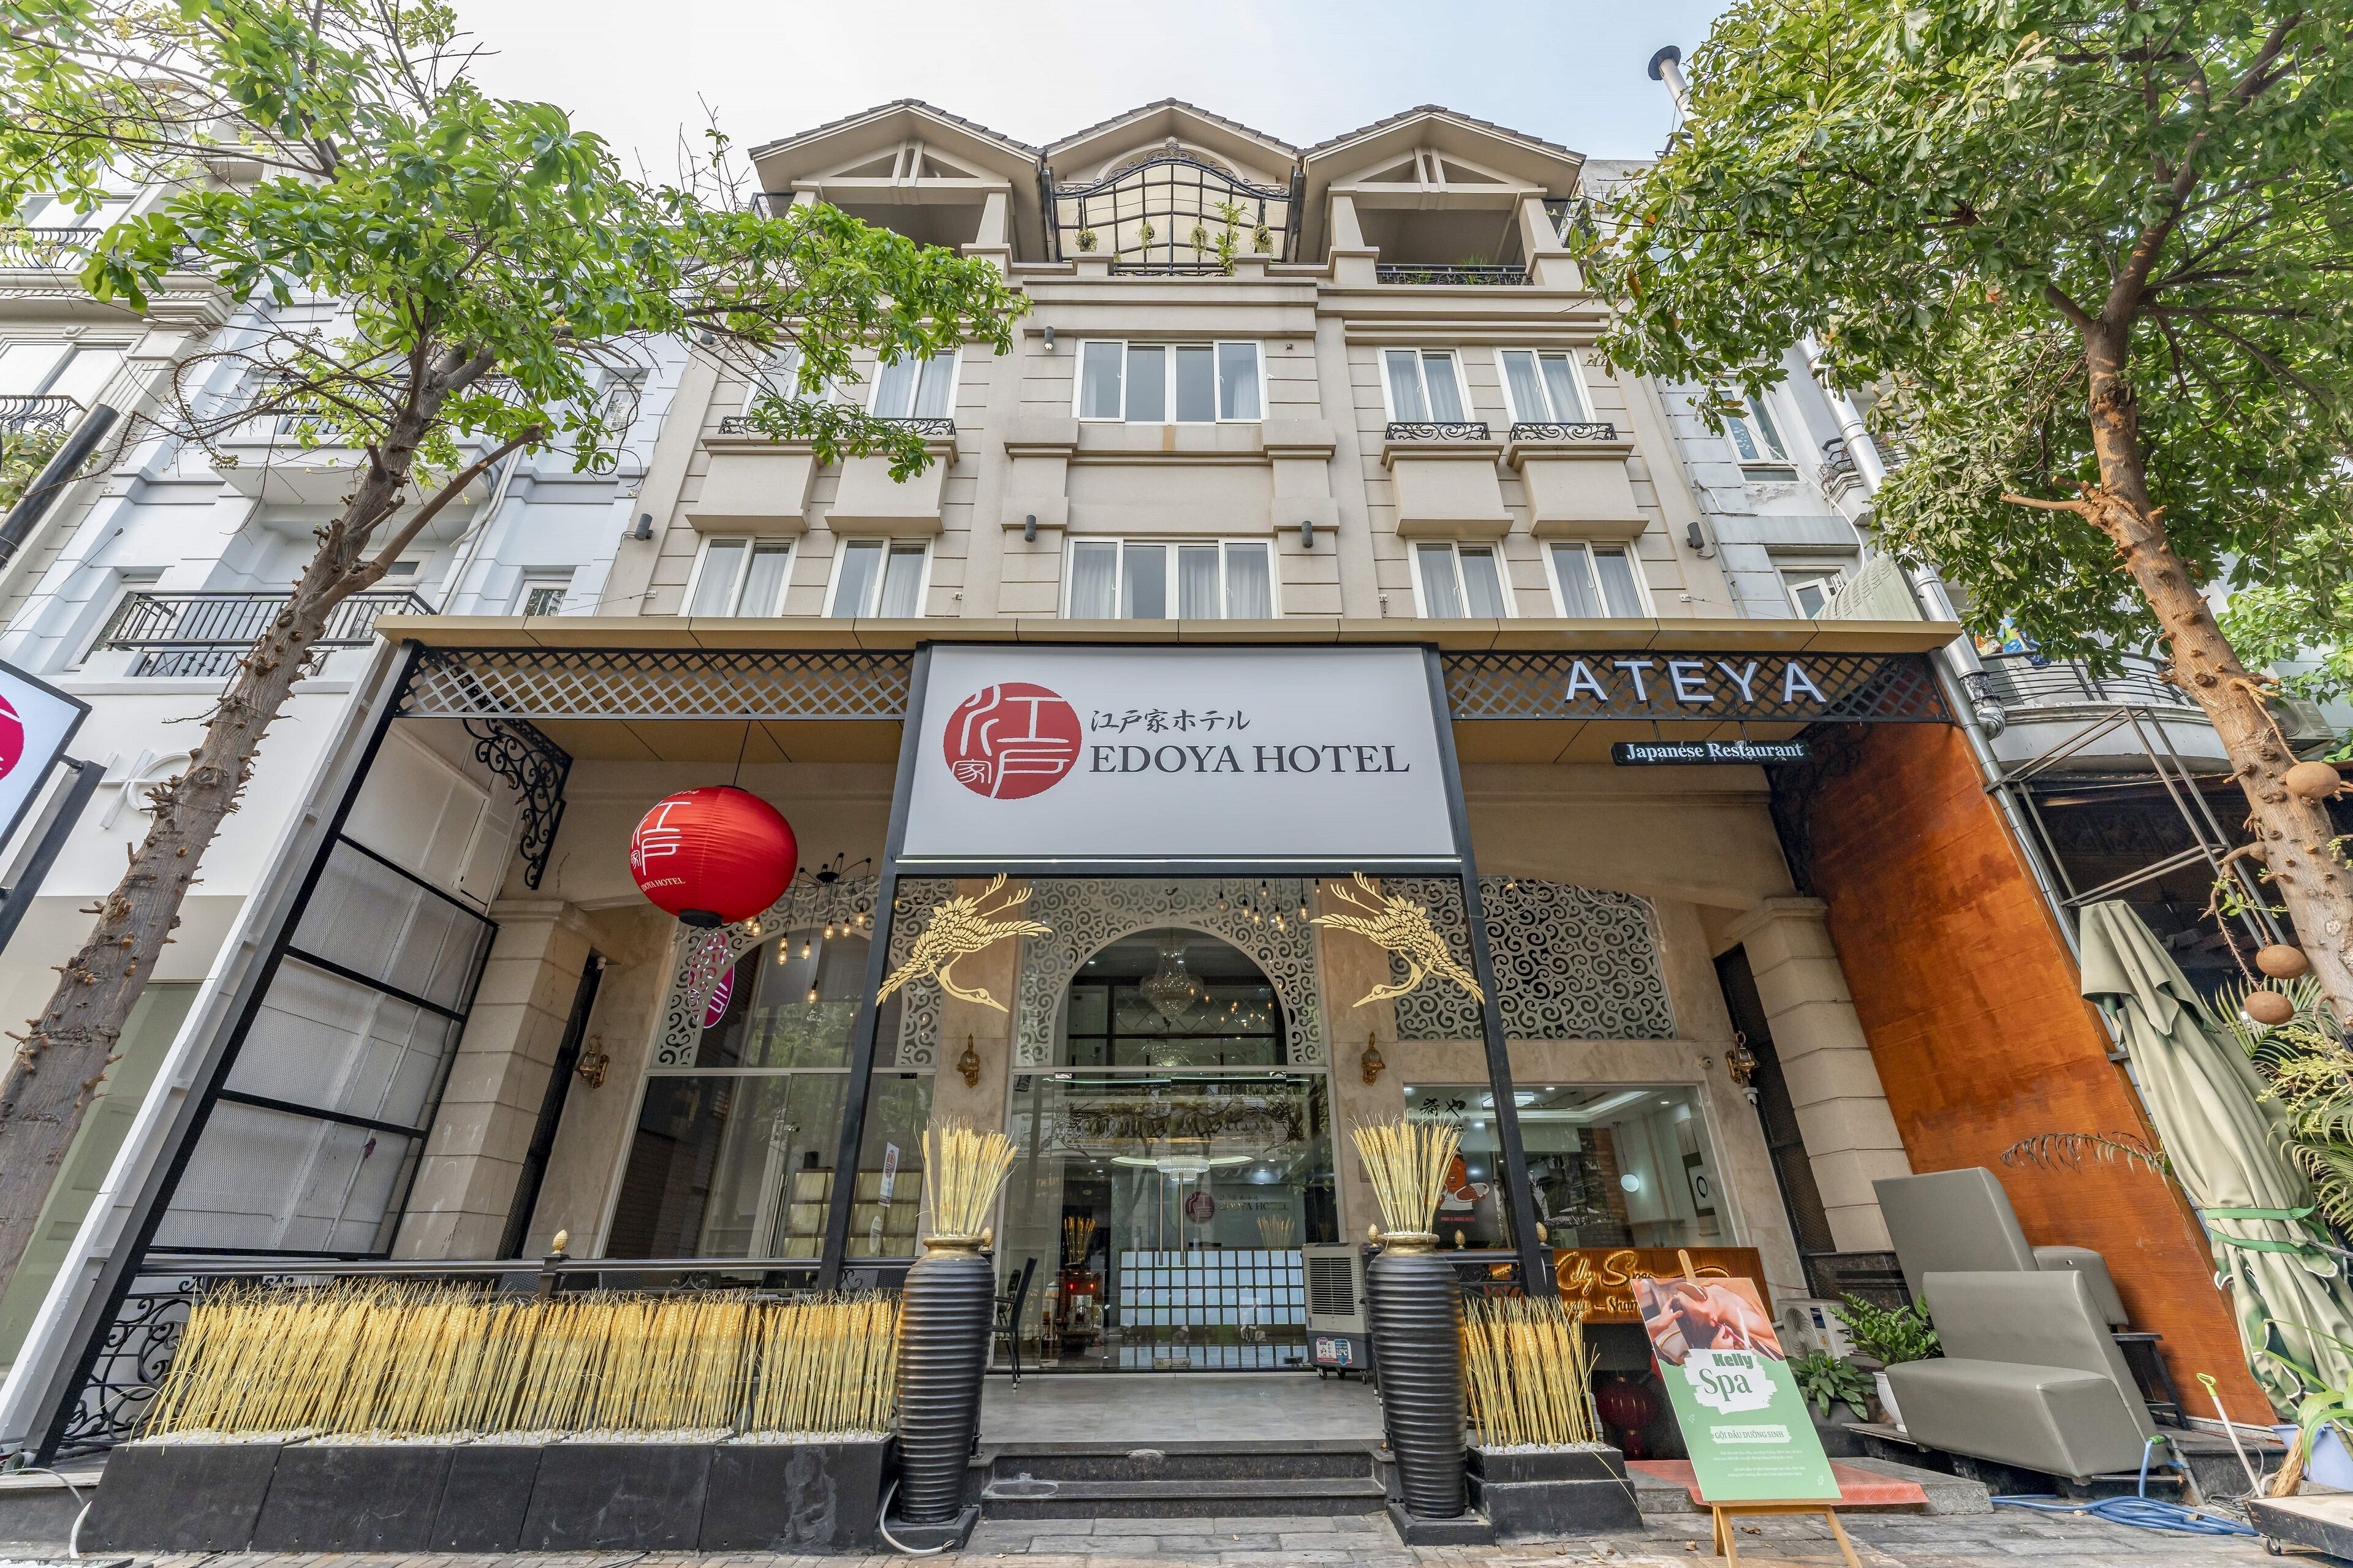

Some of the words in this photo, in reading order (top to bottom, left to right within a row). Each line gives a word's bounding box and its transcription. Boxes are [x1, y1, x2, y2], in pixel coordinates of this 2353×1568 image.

[1564, 661, 1827, 705] ATEYA
[1089, 708, 1251, 734] 江戸家ホテル
[1088, 744, 1245, 773] EDOYA
[1252, 744, 1411, 773] HOTEL
[1626, 744, 1704, 761] Japanese
[1706, 743, 1804, 758] Restaurant
[654, 877, 686, 887] HOTEL
[1711, 1353, 1754, 1369] Kelly
[1699, 1368, 1753, 1401] Spa
